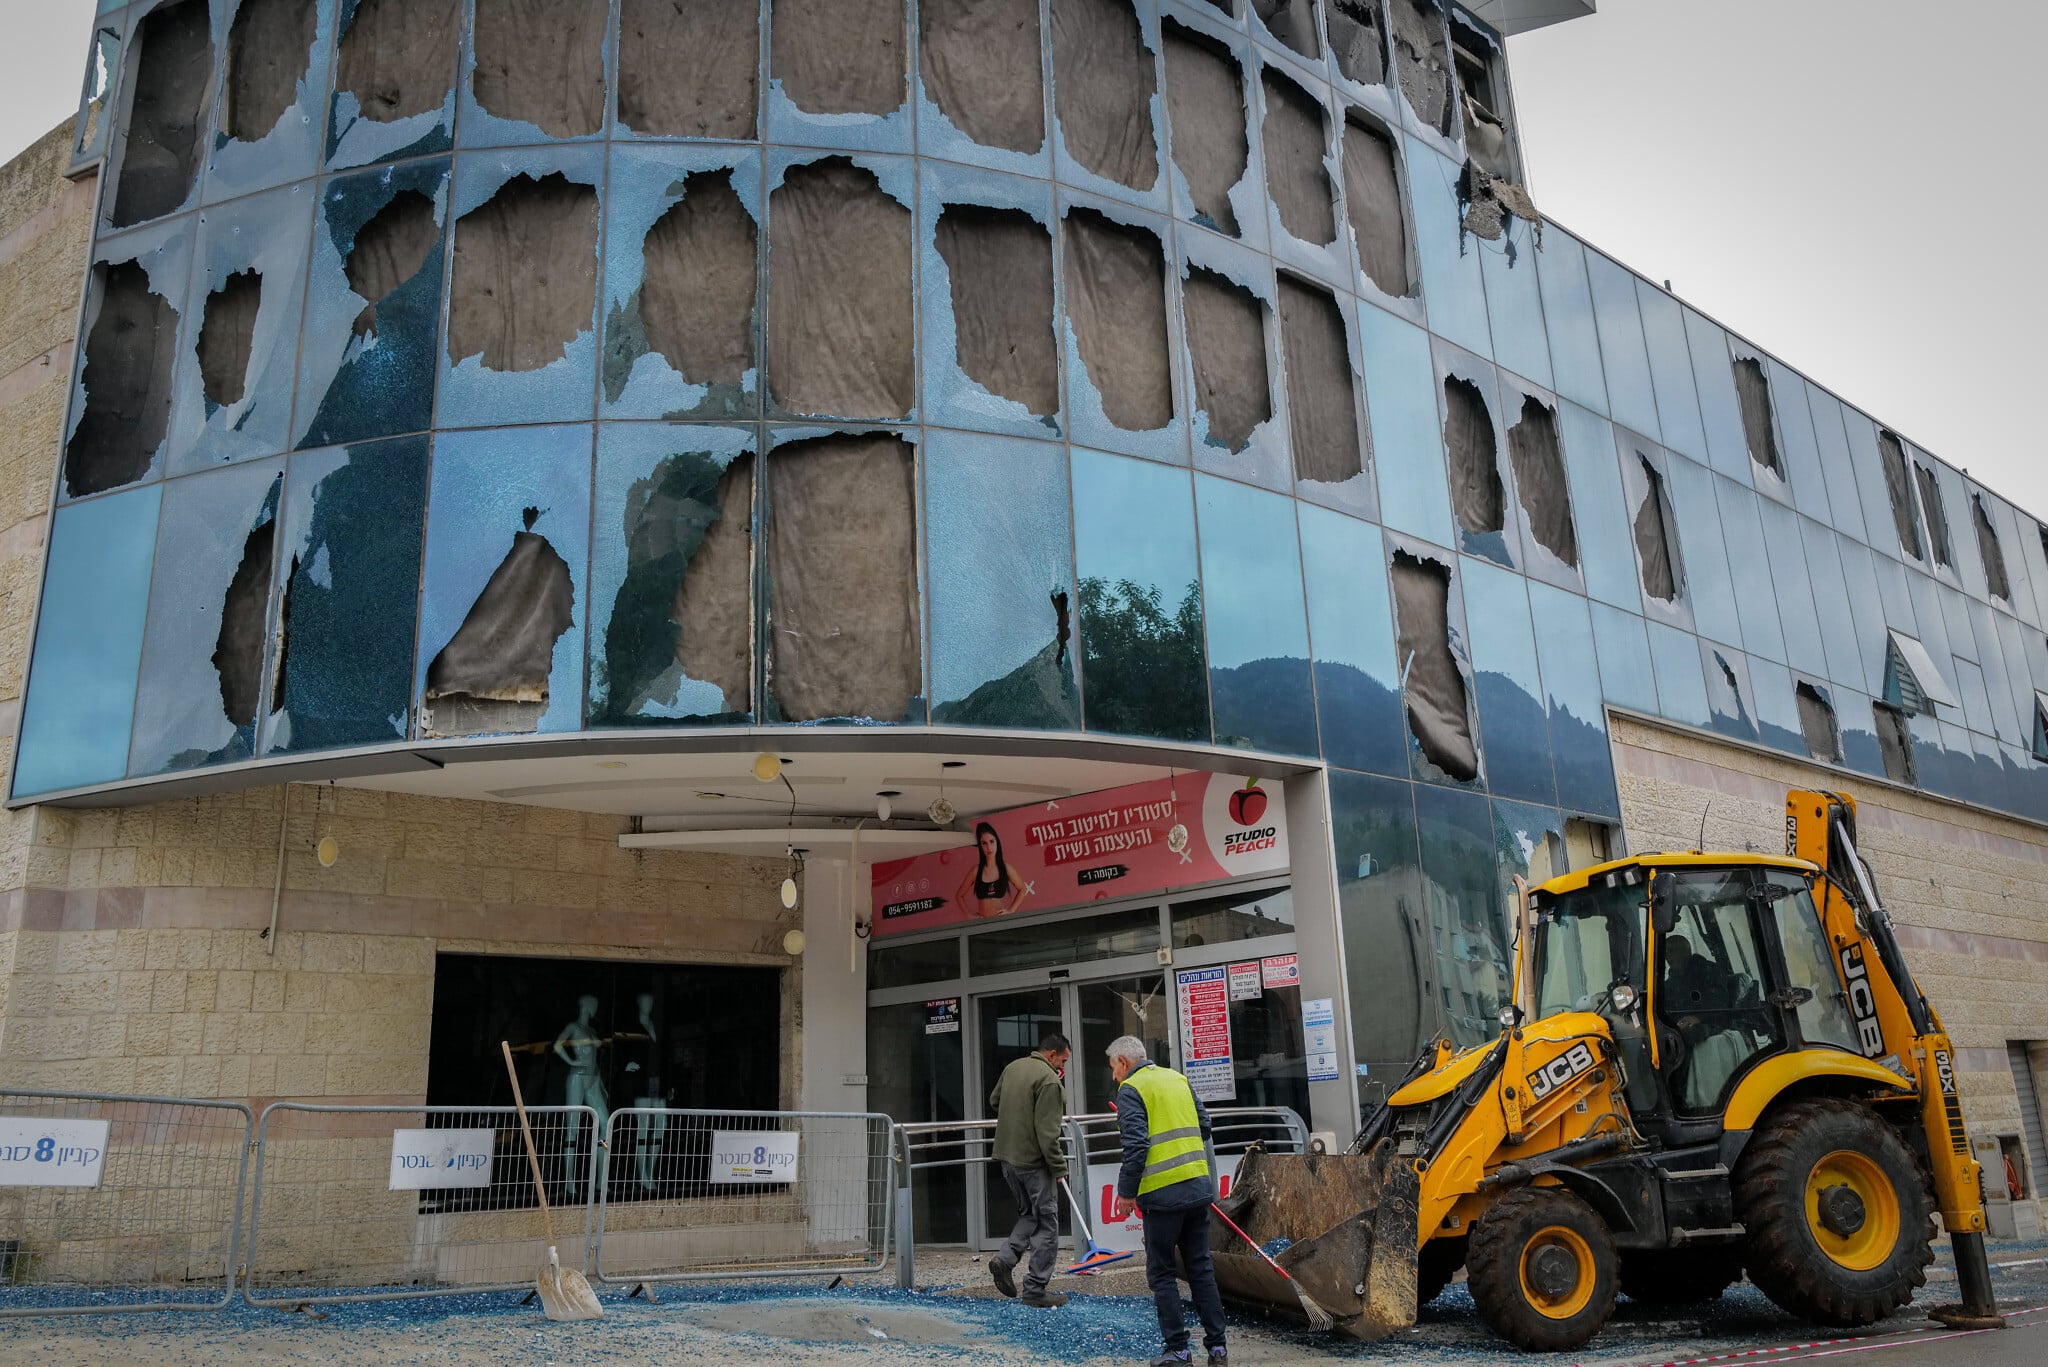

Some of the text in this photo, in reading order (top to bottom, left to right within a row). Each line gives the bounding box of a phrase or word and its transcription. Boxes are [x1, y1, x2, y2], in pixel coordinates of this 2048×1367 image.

[1032, 800, 1173, 847] סטודיו לחיטוב הגוף
[1055, 827, 1152, 862] והעצמה נשית
[1224, 827, 1276, 845] STUDIO
[1787, 817, 1797, 857] 3CX
[1225, 837, 1276, 856] PEACH
[1093, 866, 1119, 880] בקומה
[888, 899, 933, 916] 054-9591182
[1266, 957, 1294, 966] אזהרה
[1180, 970, 1222, 983] הוראות ונהלים
[1841, 948, 1883, 1058] JCB
[1533, 1044, 1593, 1097] JCB
[1935, 1051, 1956, 1093] 3CX
[0, 1137, 99, 1167] קניון 8 סנ
[716, 1146, 795, 1168] קניון 8 סנטר
[457, 1154, 487, 1171] קניון
[1125, 1223, 1145, 1232] SINC
